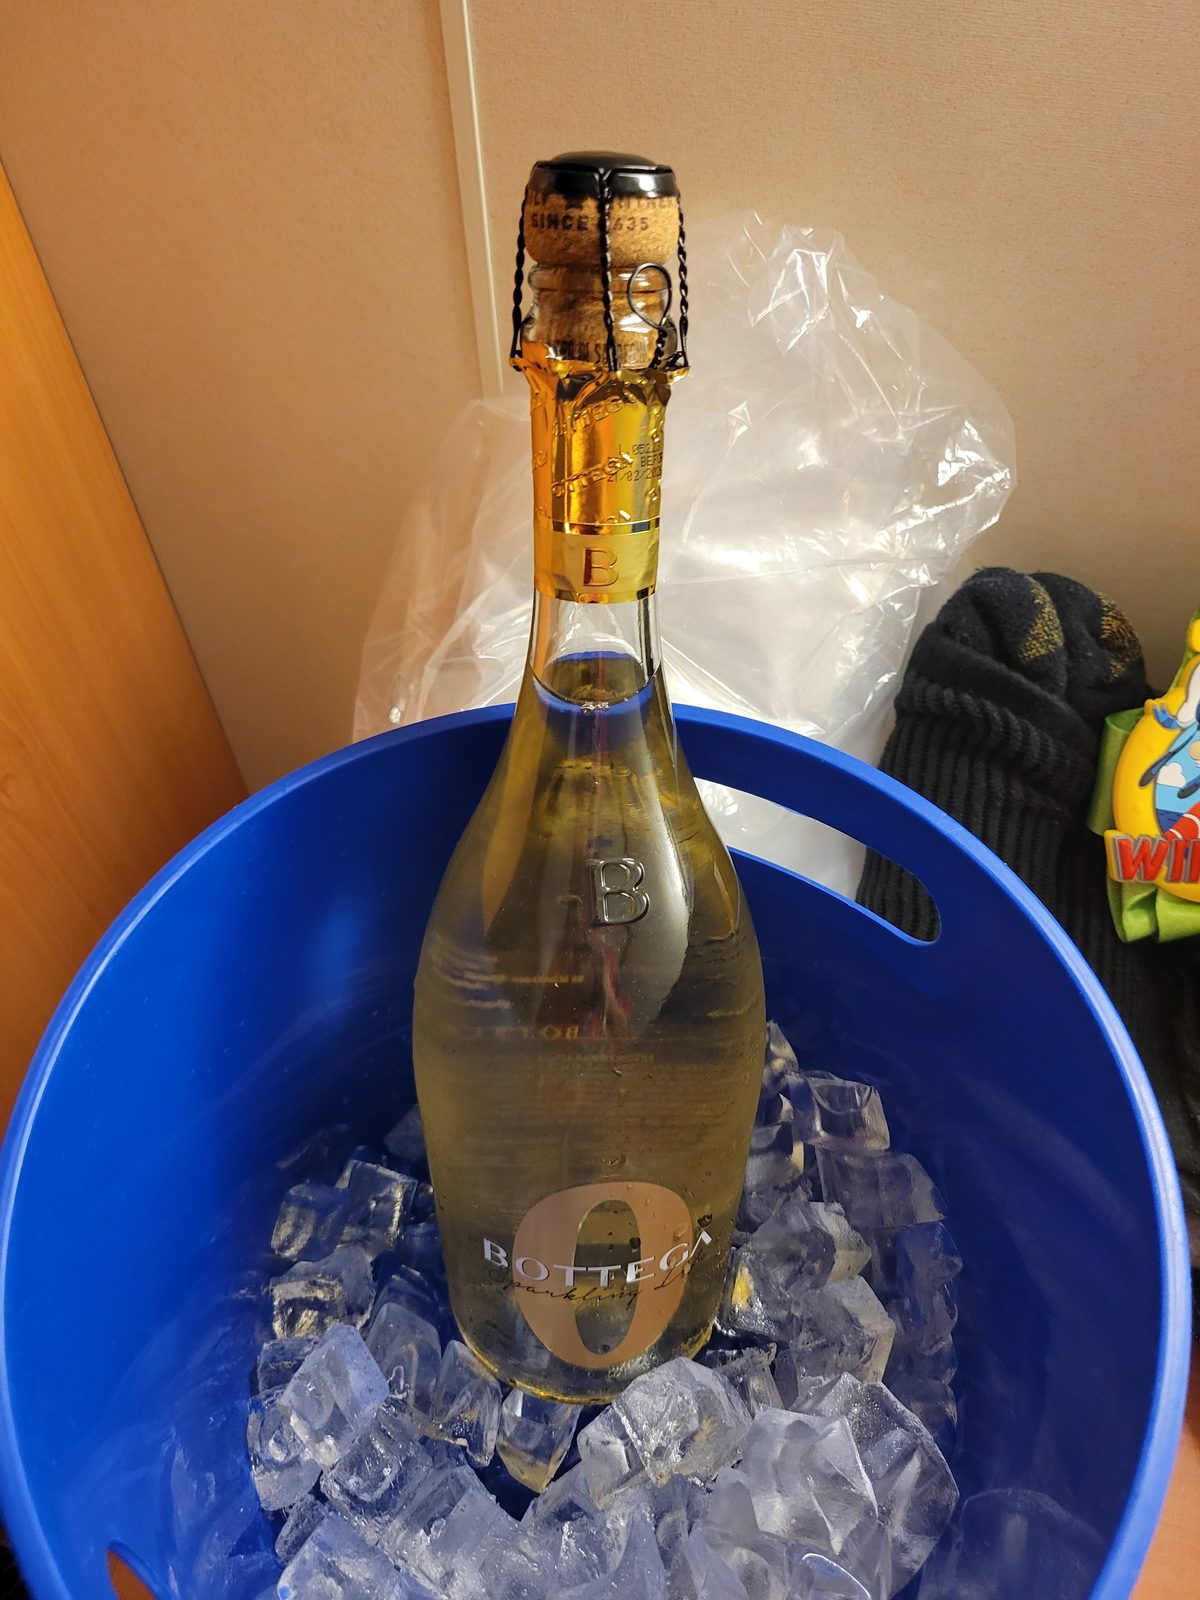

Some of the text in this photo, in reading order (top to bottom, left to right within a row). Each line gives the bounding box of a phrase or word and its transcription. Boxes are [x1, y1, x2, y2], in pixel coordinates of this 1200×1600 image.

[531, 212, 649, 231] SINCE 635
[583, 547, 619, 587] B
[589, 857, 650, 927] B
[483, 1230, 713, 1287] BOTTEGA
